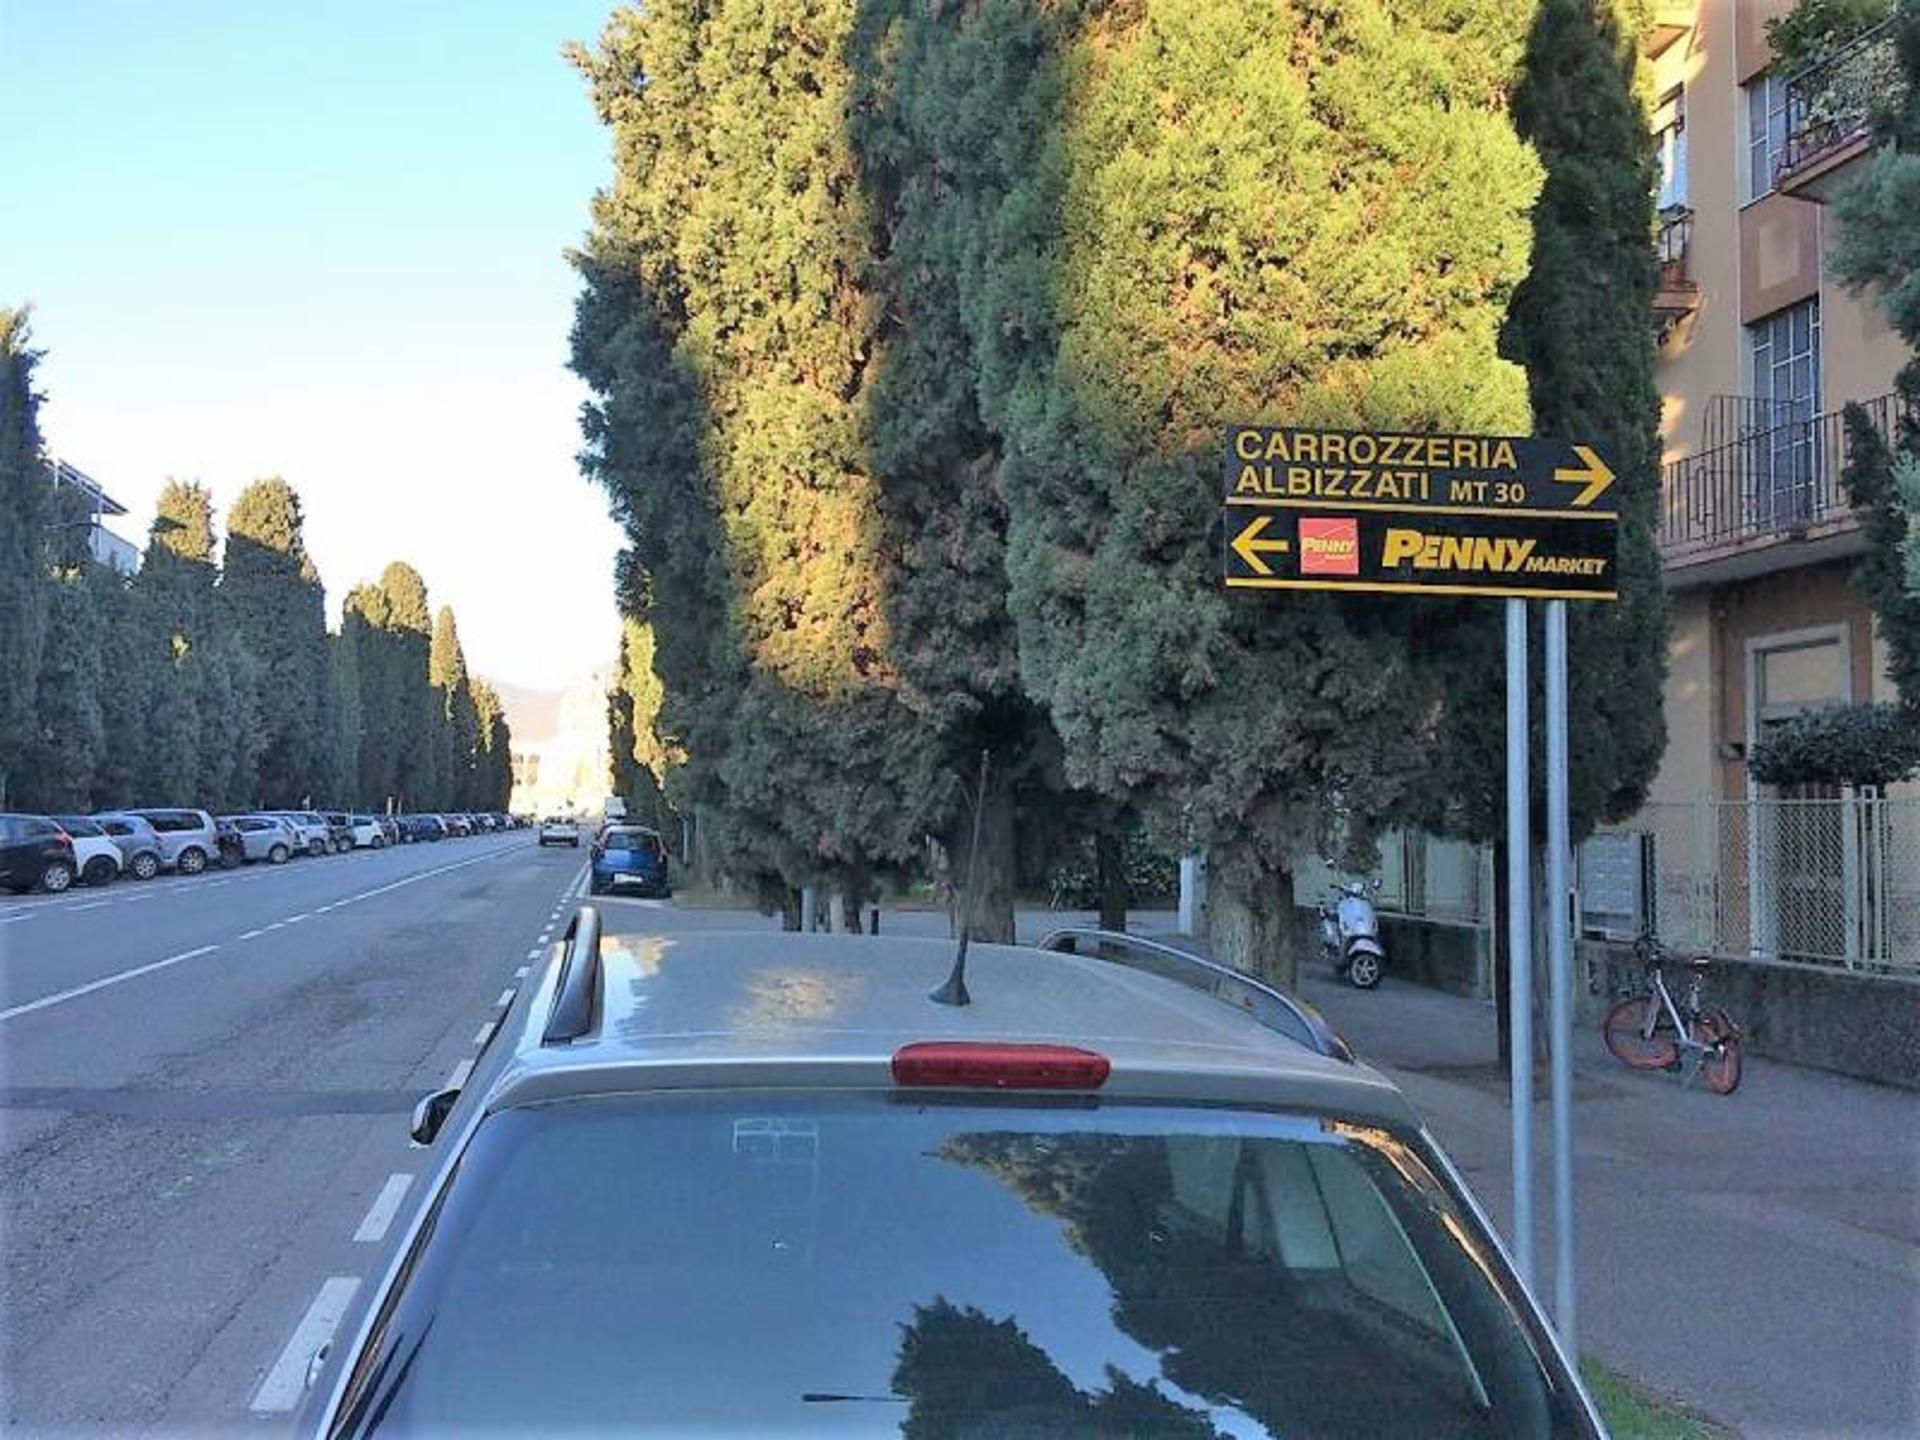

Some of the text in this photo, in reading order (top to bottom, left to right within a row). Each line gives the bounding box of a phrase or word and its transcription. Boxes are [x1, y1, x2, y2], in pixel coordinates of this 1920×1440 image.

[1235, 430, 1518, 469] CARROZZERIA
[1235, 466, 1526, 504] ALBIZZATI MT 30
[1301, 536, 1356, 554] PENNY
[1383, 529, 1607, 576] PENNY MARKET
